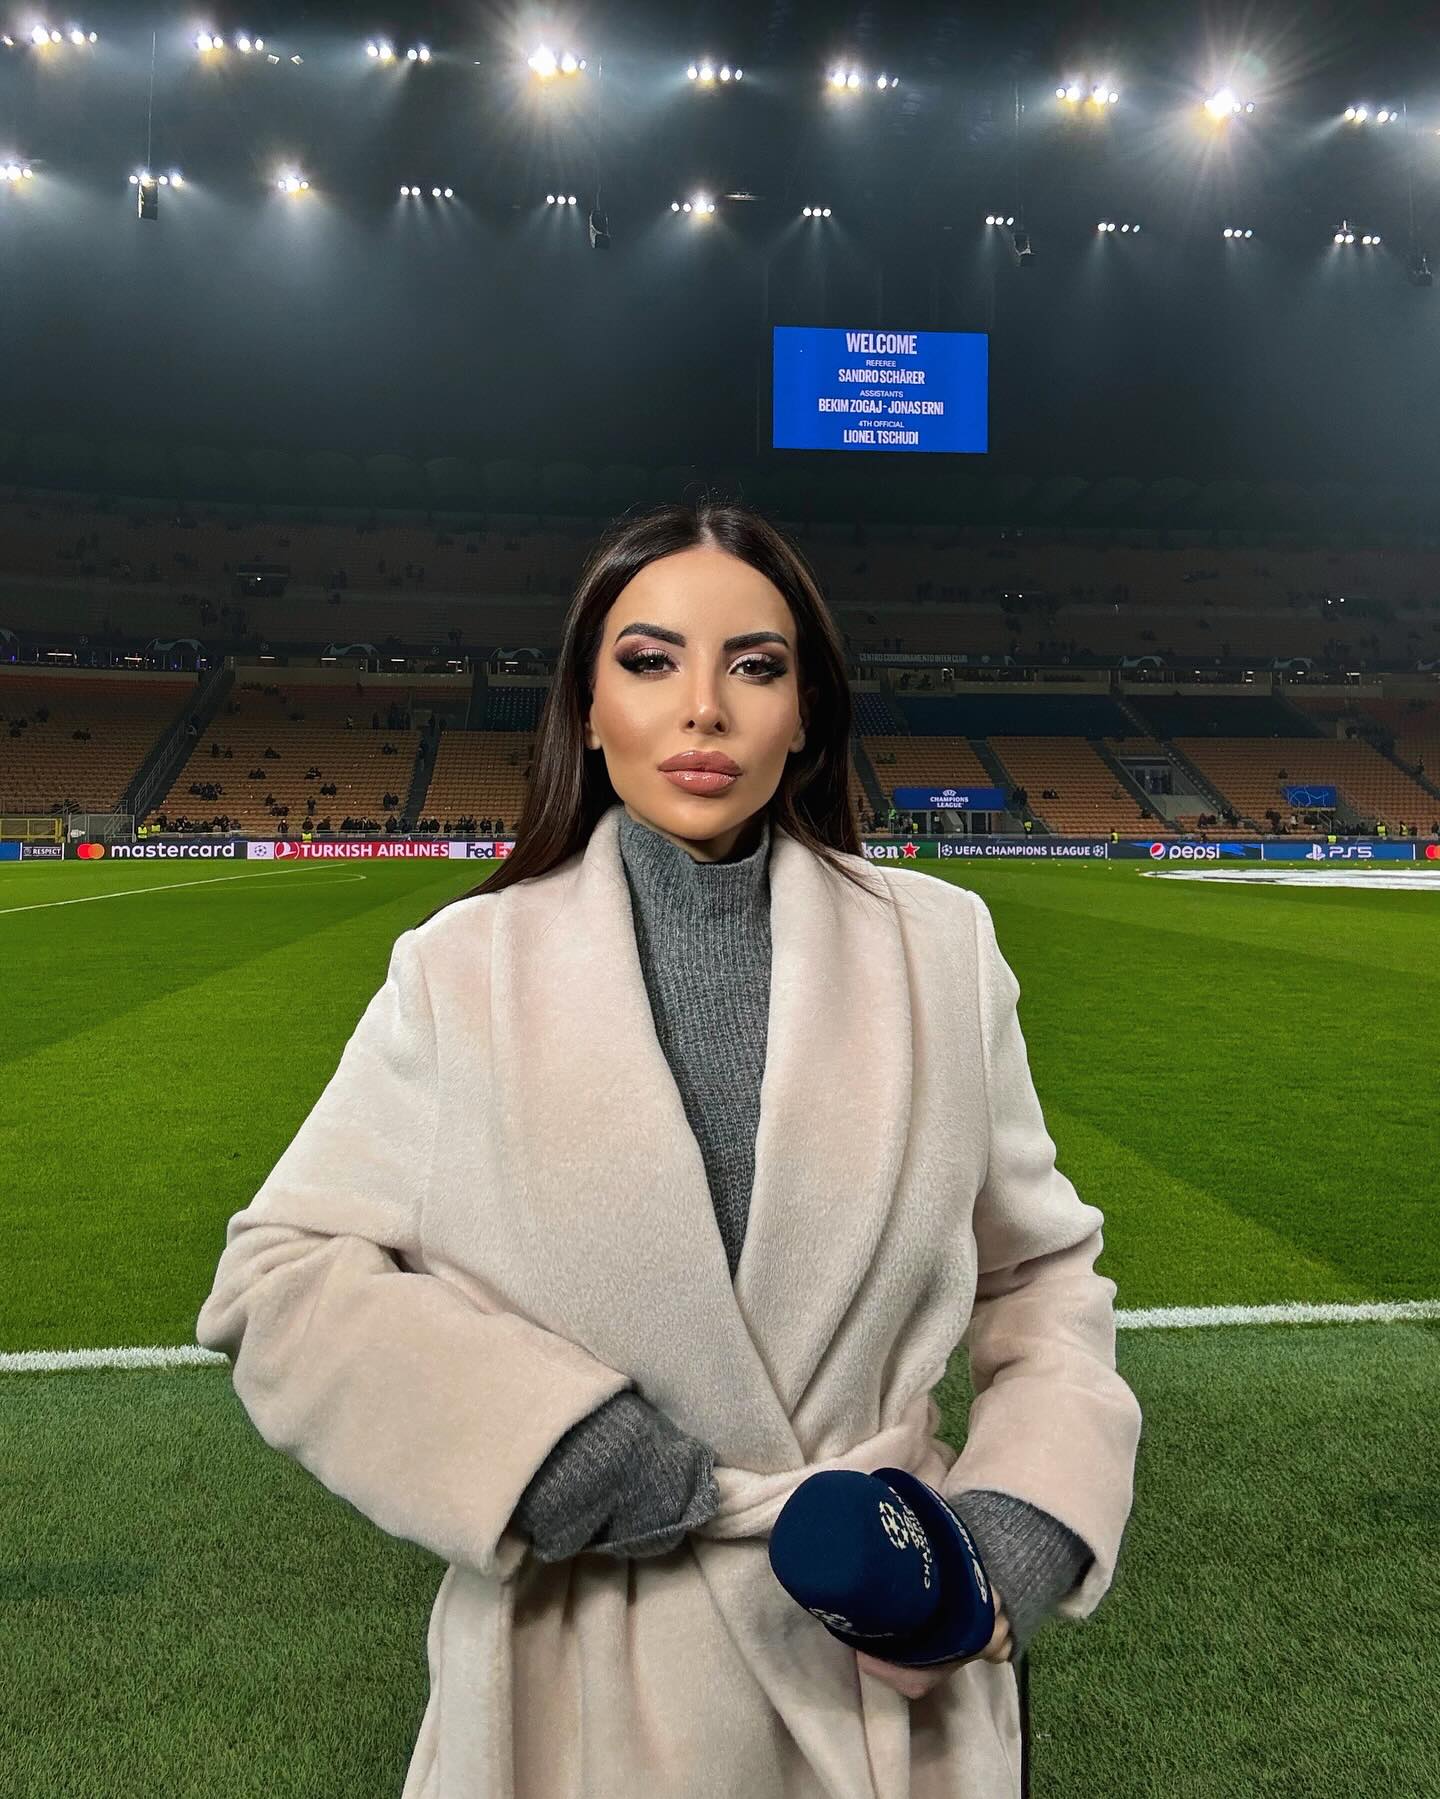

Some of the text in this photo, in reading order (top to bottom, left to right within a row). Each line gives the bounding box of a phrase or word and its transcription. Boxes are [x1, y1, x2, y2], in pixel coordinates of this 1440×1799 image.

[846, 332, 917, 354] WELCOME
[866, 359, 896, 367] REFEREE
[838, 369, 925, 384] SANDRO SCHÄRER
[860, 390, 903, 398] ASSISTANTS
[819, 399, 848, 413] BEKIM
[850, 400, 882, 414] ZOGAJ
[888, 401, 921, 414] JONAS
[922, 402, 944, 415] ERNI
[843, 430, 919, 445] LIONEL TSCHUDI
[111, 842, 234, 858] mastercard
[301, 844, 449, 857] TURKISH AIRLINES
[861, 842, 899, 858] ken
[955, 846, 1091, 856] UEFA CHAMPIONS LEAGUE
[1169, 843, 1220, 860] pepsi
[1329, 846, 1372, 858] PS5
